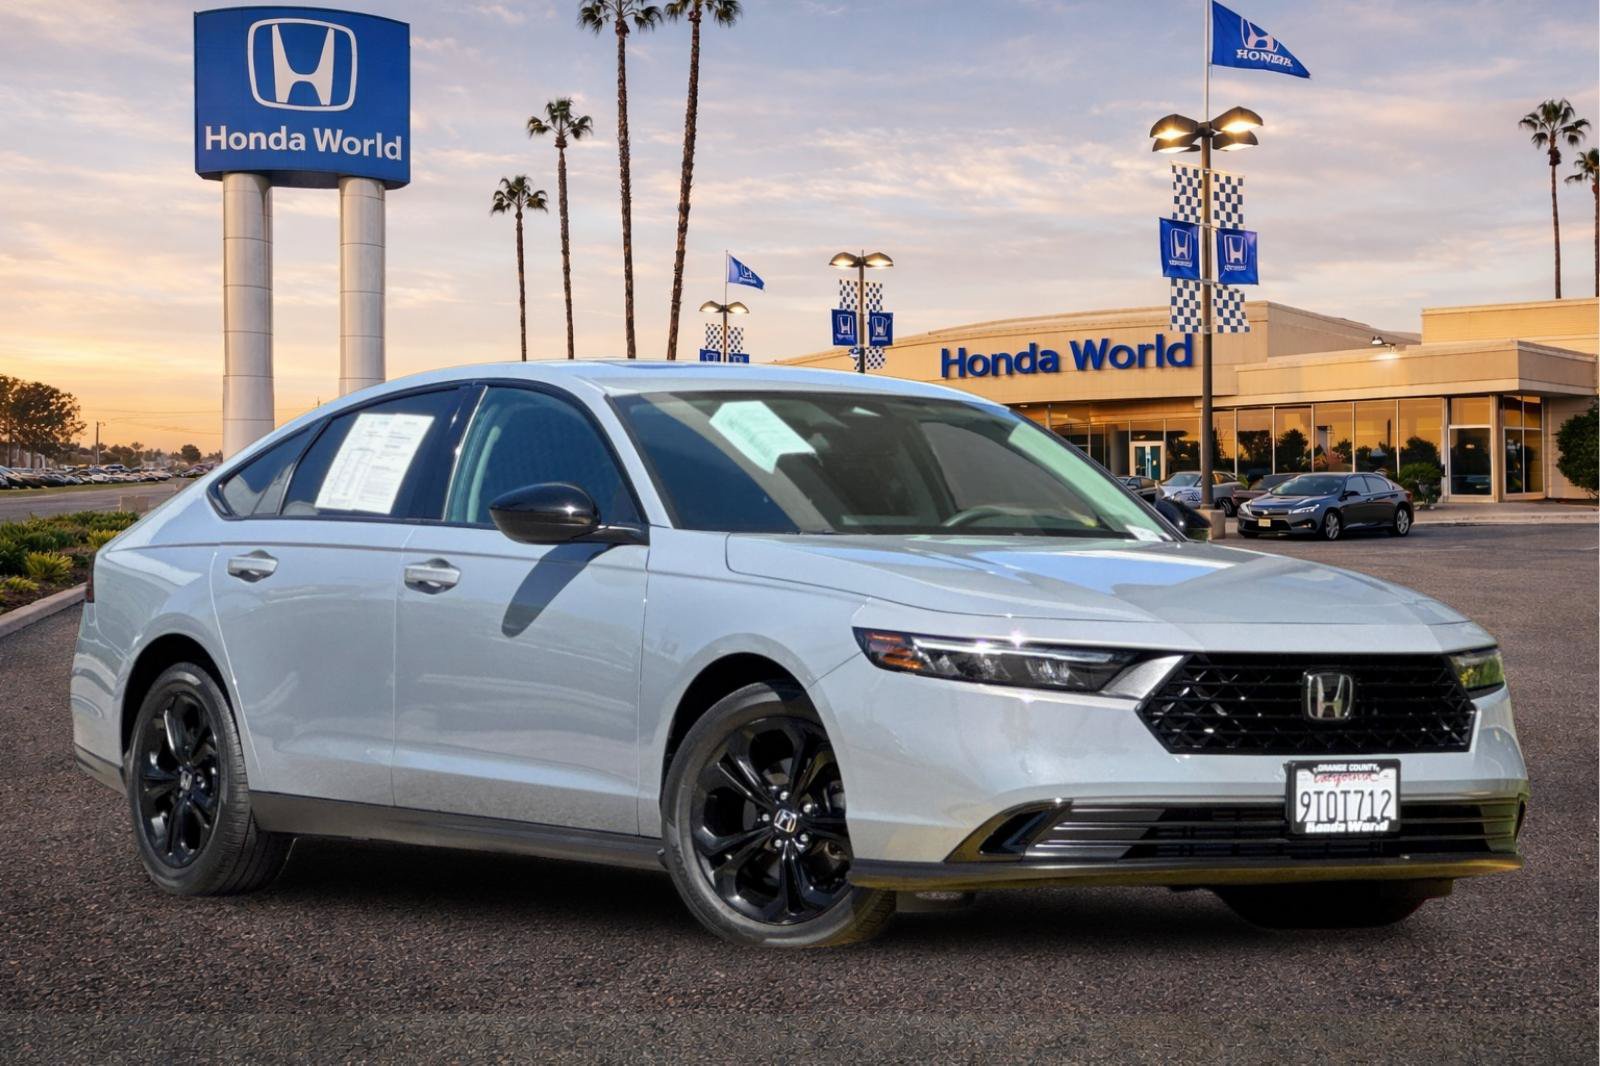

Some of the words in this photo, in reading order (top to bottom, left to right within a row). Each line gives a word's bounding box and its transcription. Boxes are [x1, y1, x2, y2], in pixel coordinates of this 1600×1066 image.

[205, 125, 306, 151] Honda
[312, 127, 403, 161] World
[941, 342, 1062, 379] Honda
[1070, 333, 1194, 372] World
[1317, 764, 1347, 772] ORANGE
[1348, 763, 1377, 771] COUNTY
[1305, 820, 1347, 833] Honda
[1347, 819, 1389, 833] World
